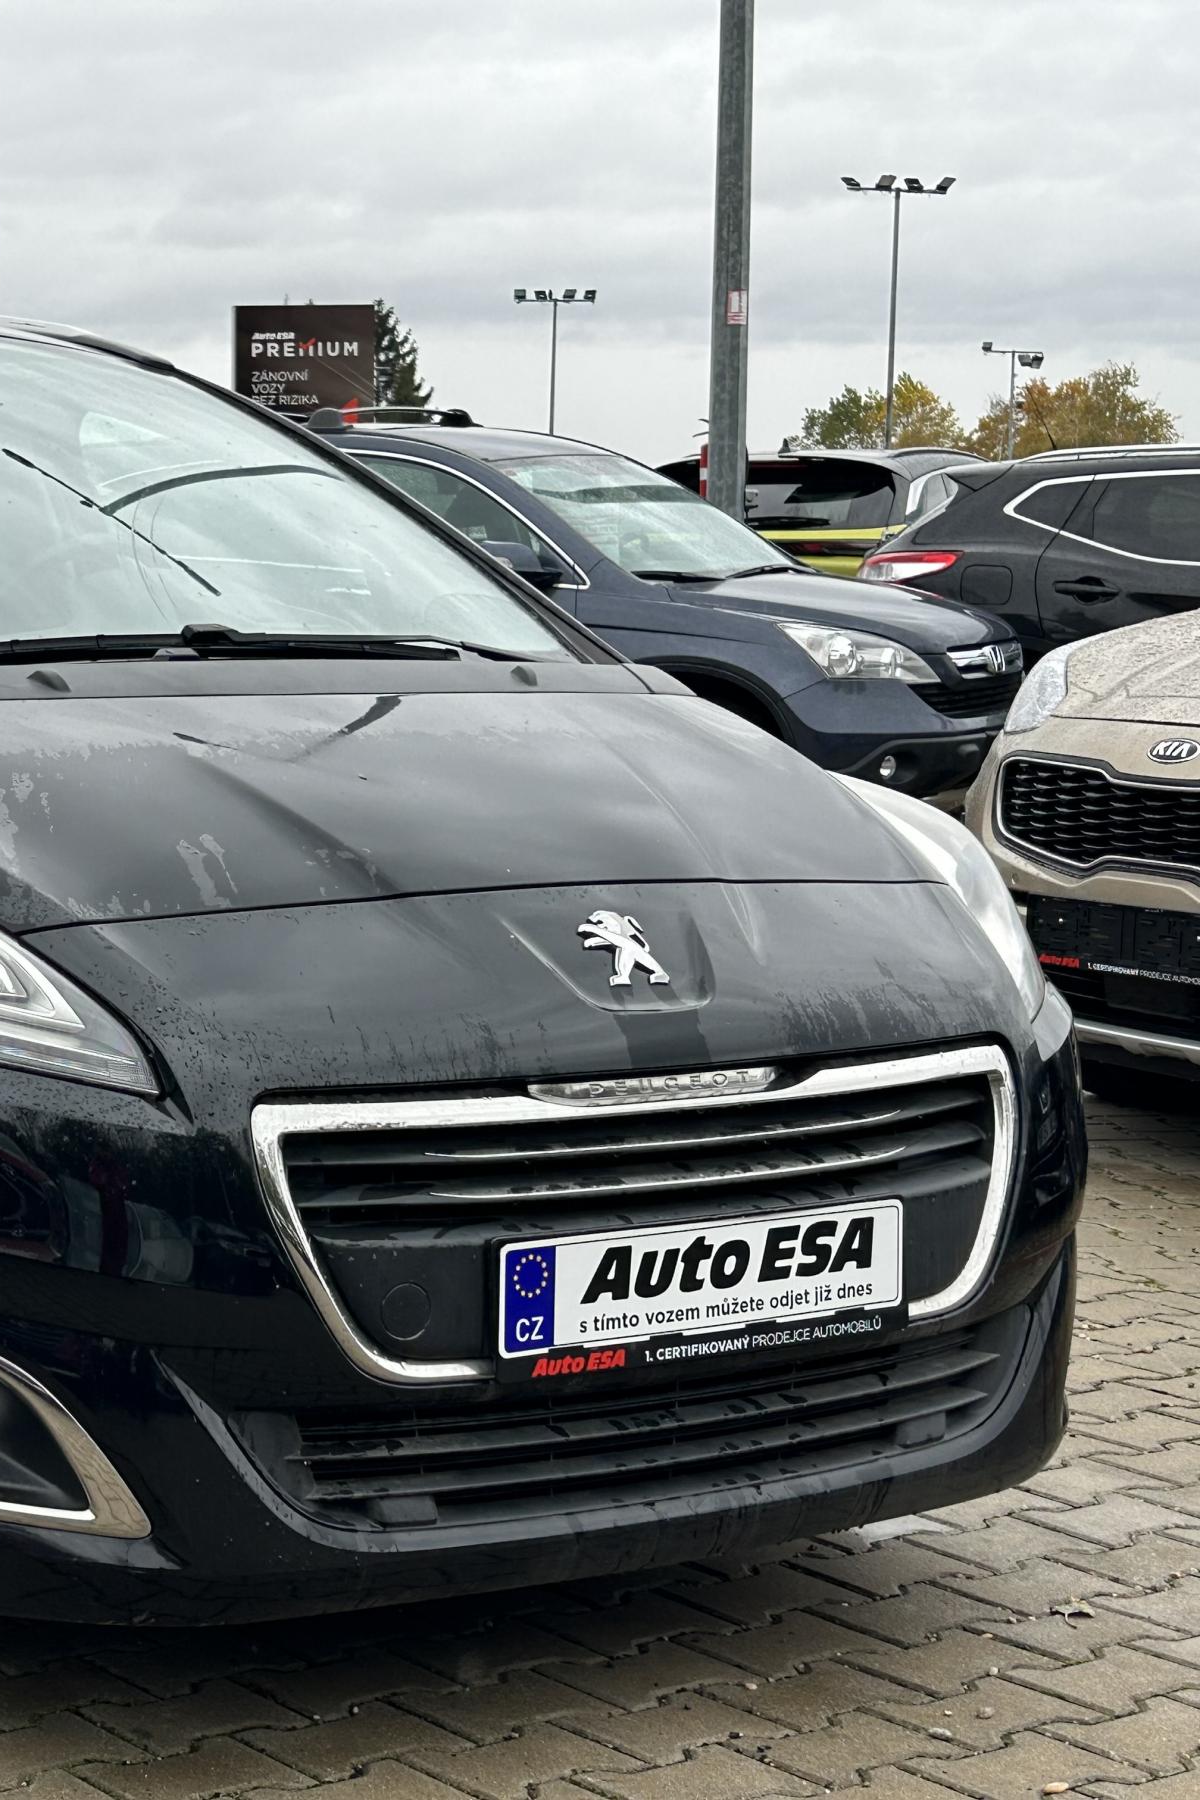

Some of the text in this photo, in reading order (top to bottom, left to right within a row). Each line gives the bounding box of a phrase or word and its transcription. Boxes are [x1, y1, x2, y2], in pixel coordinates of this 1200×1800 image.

[251, 341, 359, 358] PREMIUM
[251, 369, 309, 382] ZÁNOVNÍ
[251, 383, 286, 394] VOZY
[279, 394, 319, 405] RIZIKA
[1152, 741, 1191, 758] KIA
[580, 1216, 875, 1304] Auto ESA
[579, 1283, 873, 1333] s tímto vozem můžete odjet již dnes
[516, 1316, 544, 1342] CZ
[645, 1315, 882, 1362] 1. CERTIFIKOVANÝ PRODEJCE AUTOMOBILŮ
[532, 1349, 626, 1377] Auto ESA
